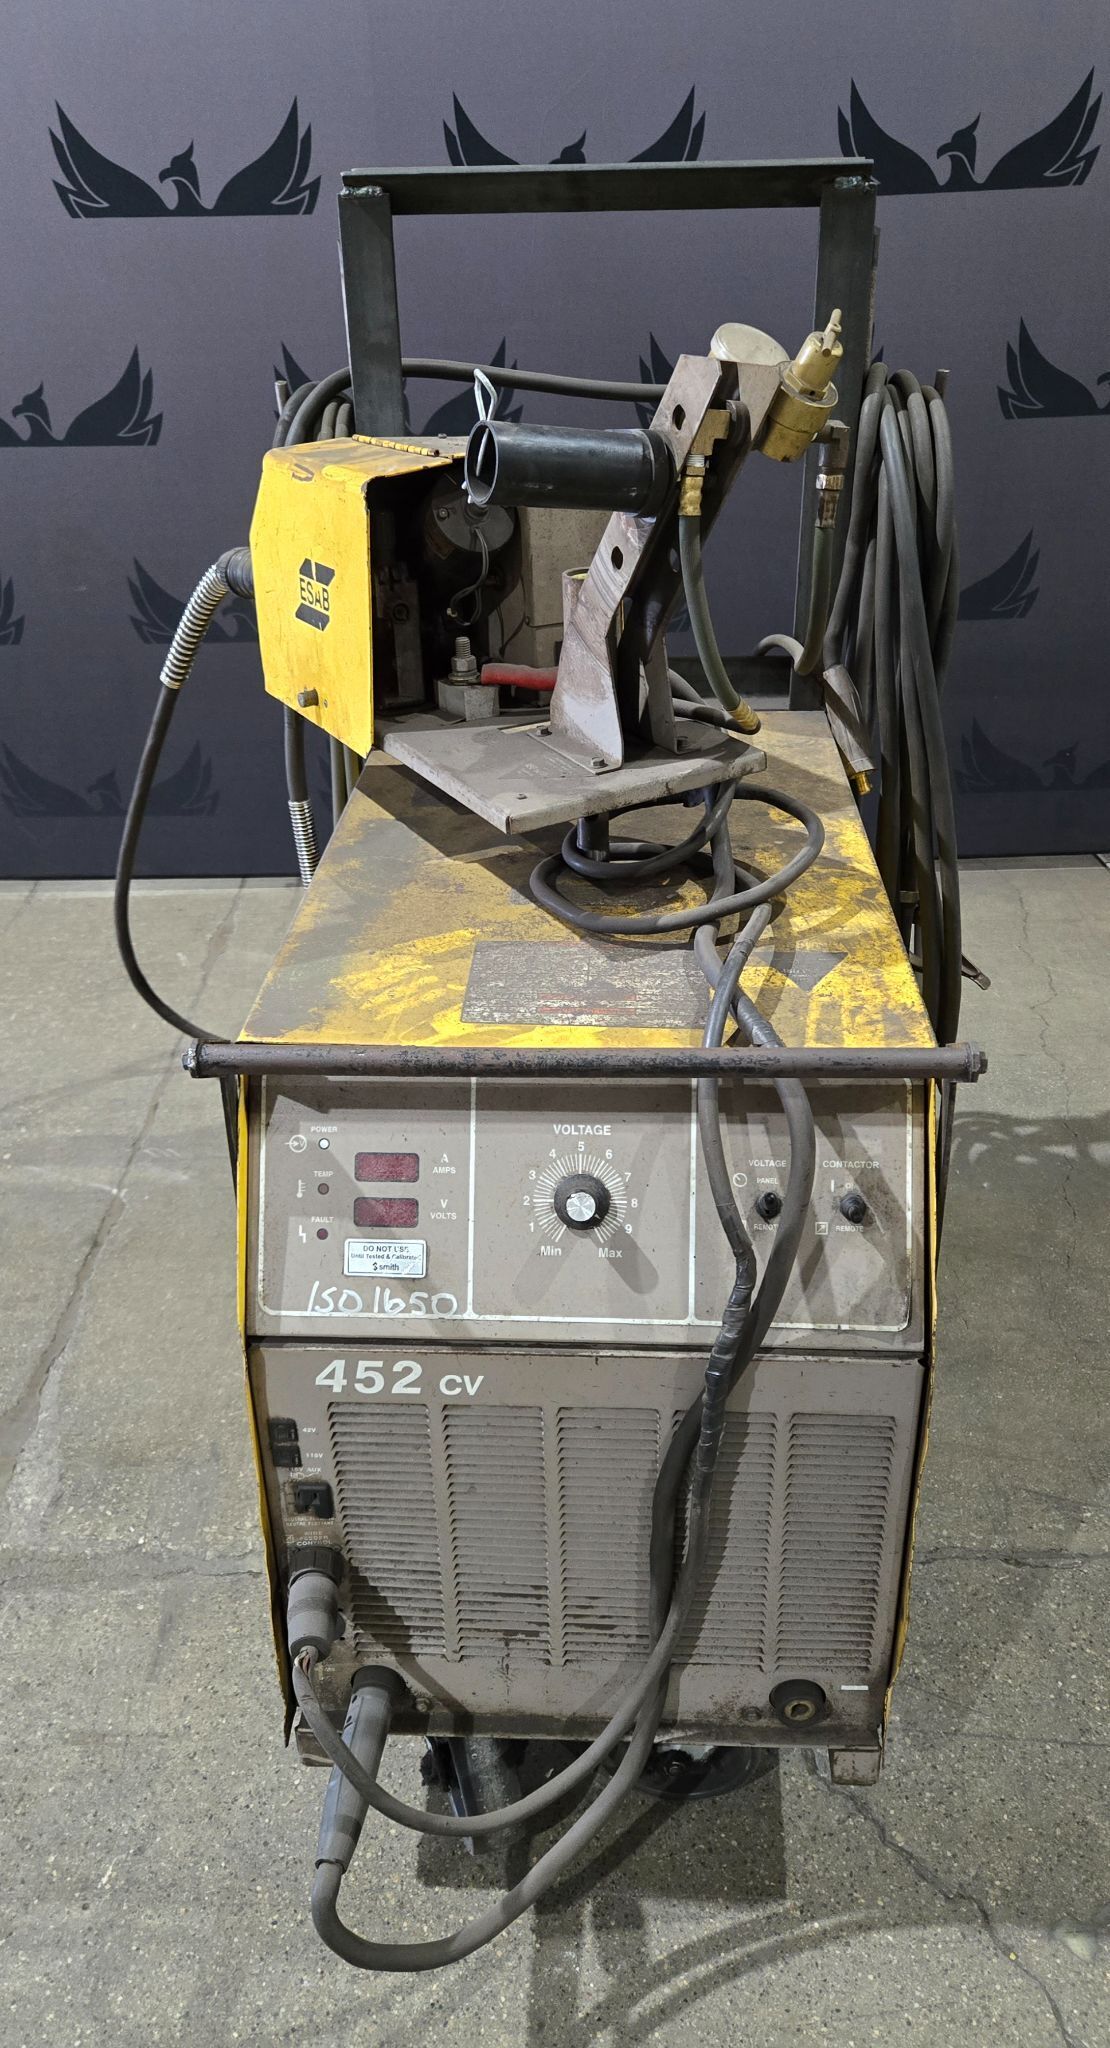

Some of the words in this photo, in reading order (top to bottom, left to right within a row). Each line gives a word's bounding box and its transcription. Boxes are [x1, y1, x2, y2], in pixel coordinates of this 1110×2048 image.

[299, 577, 330, 612] ESAB
[553, 1124, 611, 1135] VOLTAGE
[577, 1141, 585, 1151] 5
[440, 1153, 449, 1163] A
[549, 1149, 556, 1159] 4
[605, 1149, 613, 1159] 6
[748, 1159, 787, 1167] VOLTAGE
[822, 1160, 880, 1169] CONTACTOR
[313, 1170, 334, 1178] TEMP
[529, 1170, 536, 1180] 3
[624, 1172, 632, 1182] 7
[440, 1199, 448, 1208] V
[523, 1196, 530, 1206] 2
[631, 1198, 638, 1208] 8
[430, 1212, 457, 1220] VOLTS
[529, 1222, 534, 1232] 1
[625, 1224, 632, 1234] 9
[753, 1223, 779, 1231] REMOT
[540, 1246, 562, 1256] Min
[598, 1247, 623, 1258] Max
[379, 1263, 400, 1271] smith
[315, 1359, 423, 1394] 452
